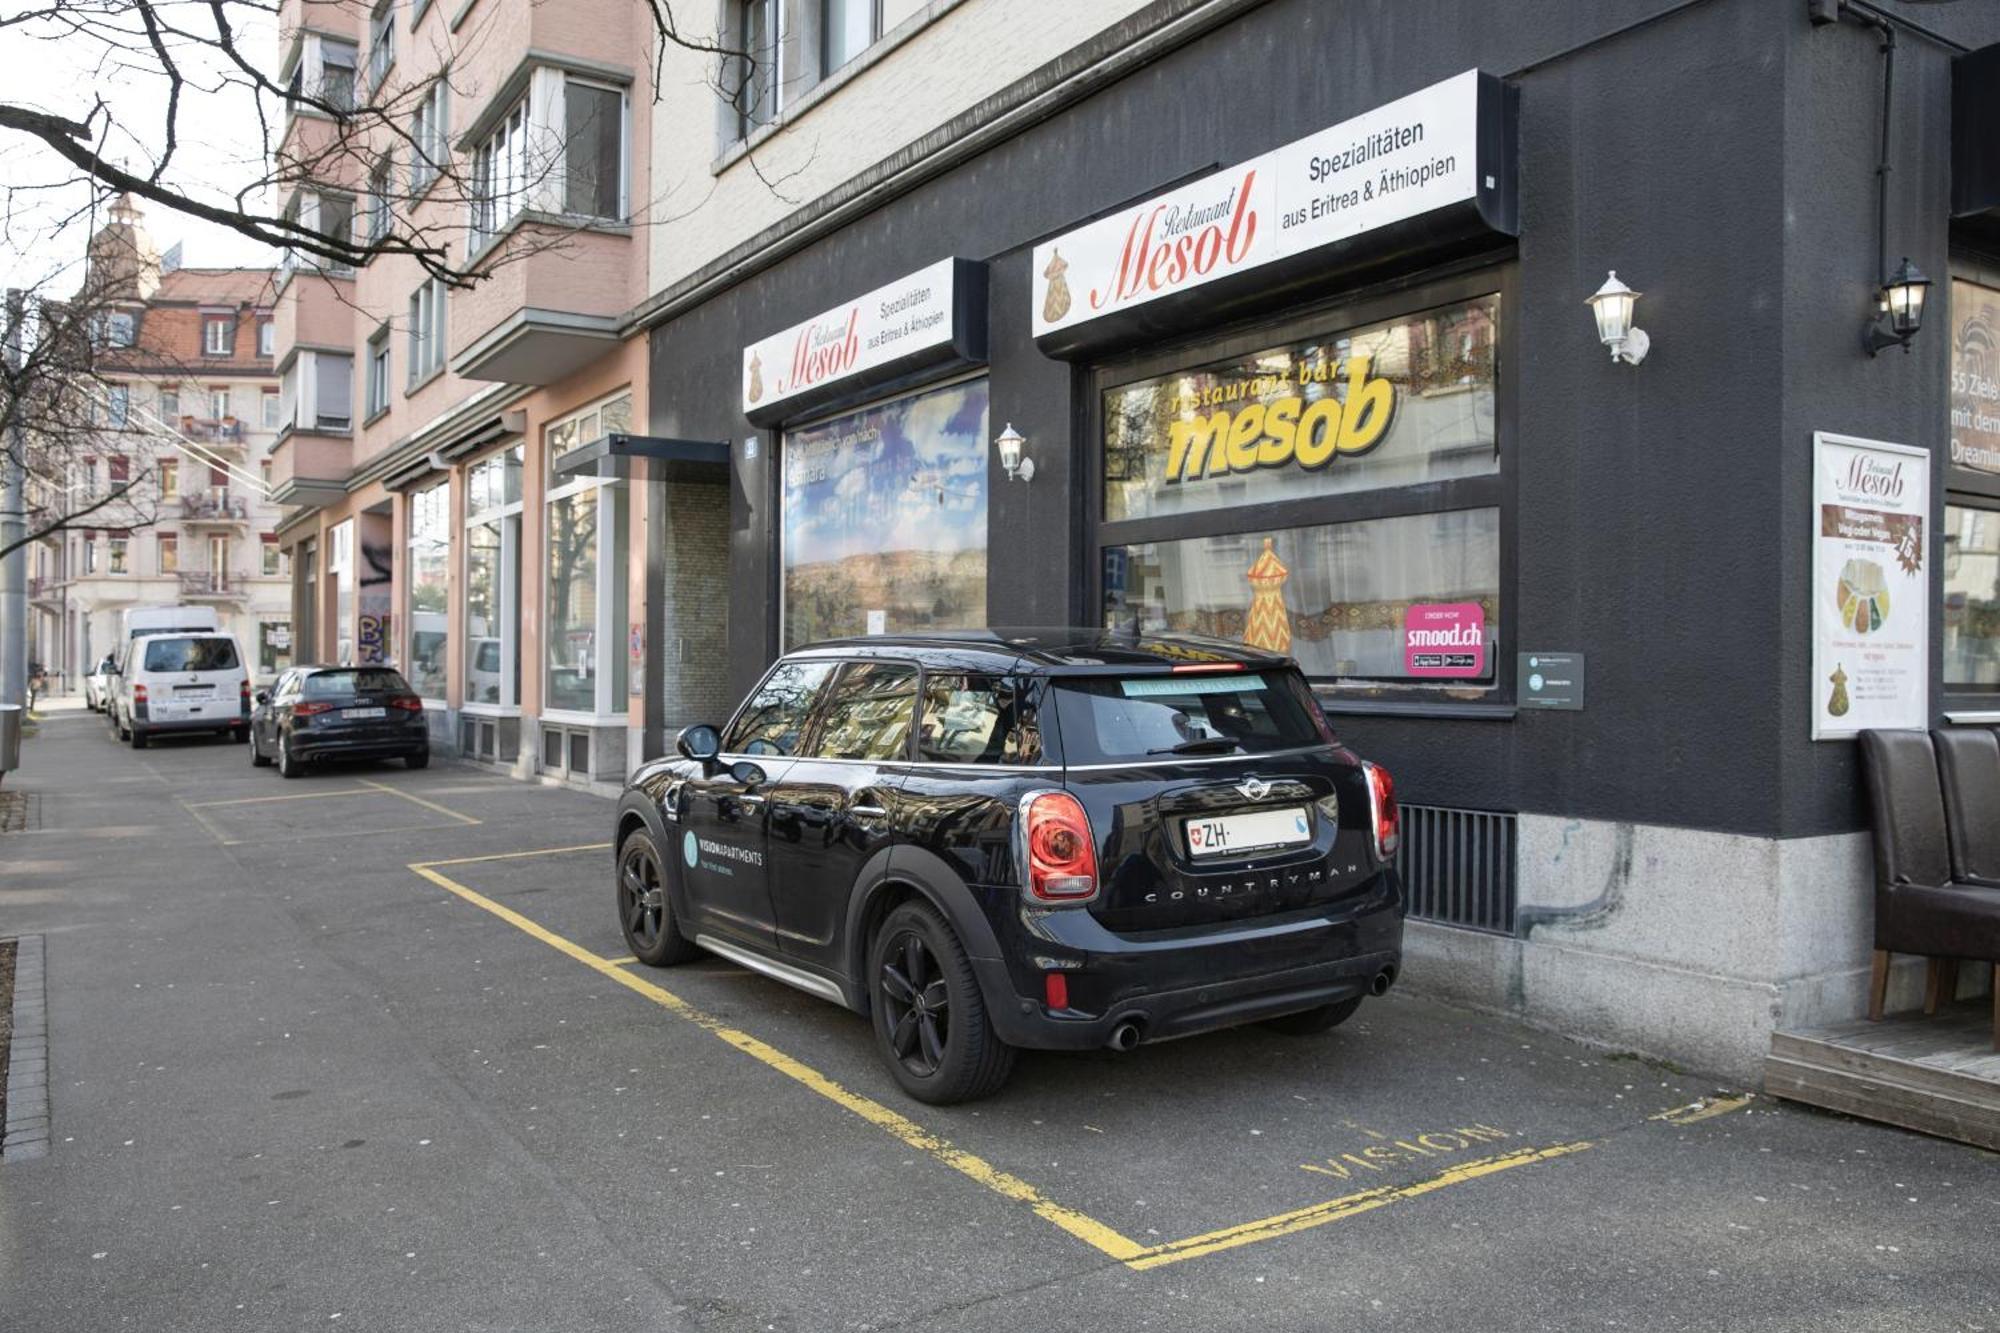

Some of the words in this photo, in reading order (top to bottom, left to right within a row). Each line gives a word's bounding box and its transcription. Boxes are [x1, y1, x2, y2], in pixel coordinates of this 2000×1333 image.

[1309, 122, 1424, 183] Spezialitäten
[1160, 186, 1236, 239] Restaurant
[1282, 207, 1307, 229] aus
[1311, 189, 1359, 220] Eritrea
[1363, 180, 1374, 201] &
[1378, 155, 1456, 198] Äthiopien
[1090, 170, 1257, 310] Mesob
[880, 287, 931, 320] Spezialitäten
[778, 308, 859, 394] Mesob
[1299, 360, 1339, 385] bar
[1166, 356, 1396, 483] mesob
[1951, 407, 1972, 429] mit
[1835, 454, 1904, 498] Mesob
[1408, 622, 1482, 647] smood.ch
[1144, 864, 1357, 902] COUNTRYMAN
